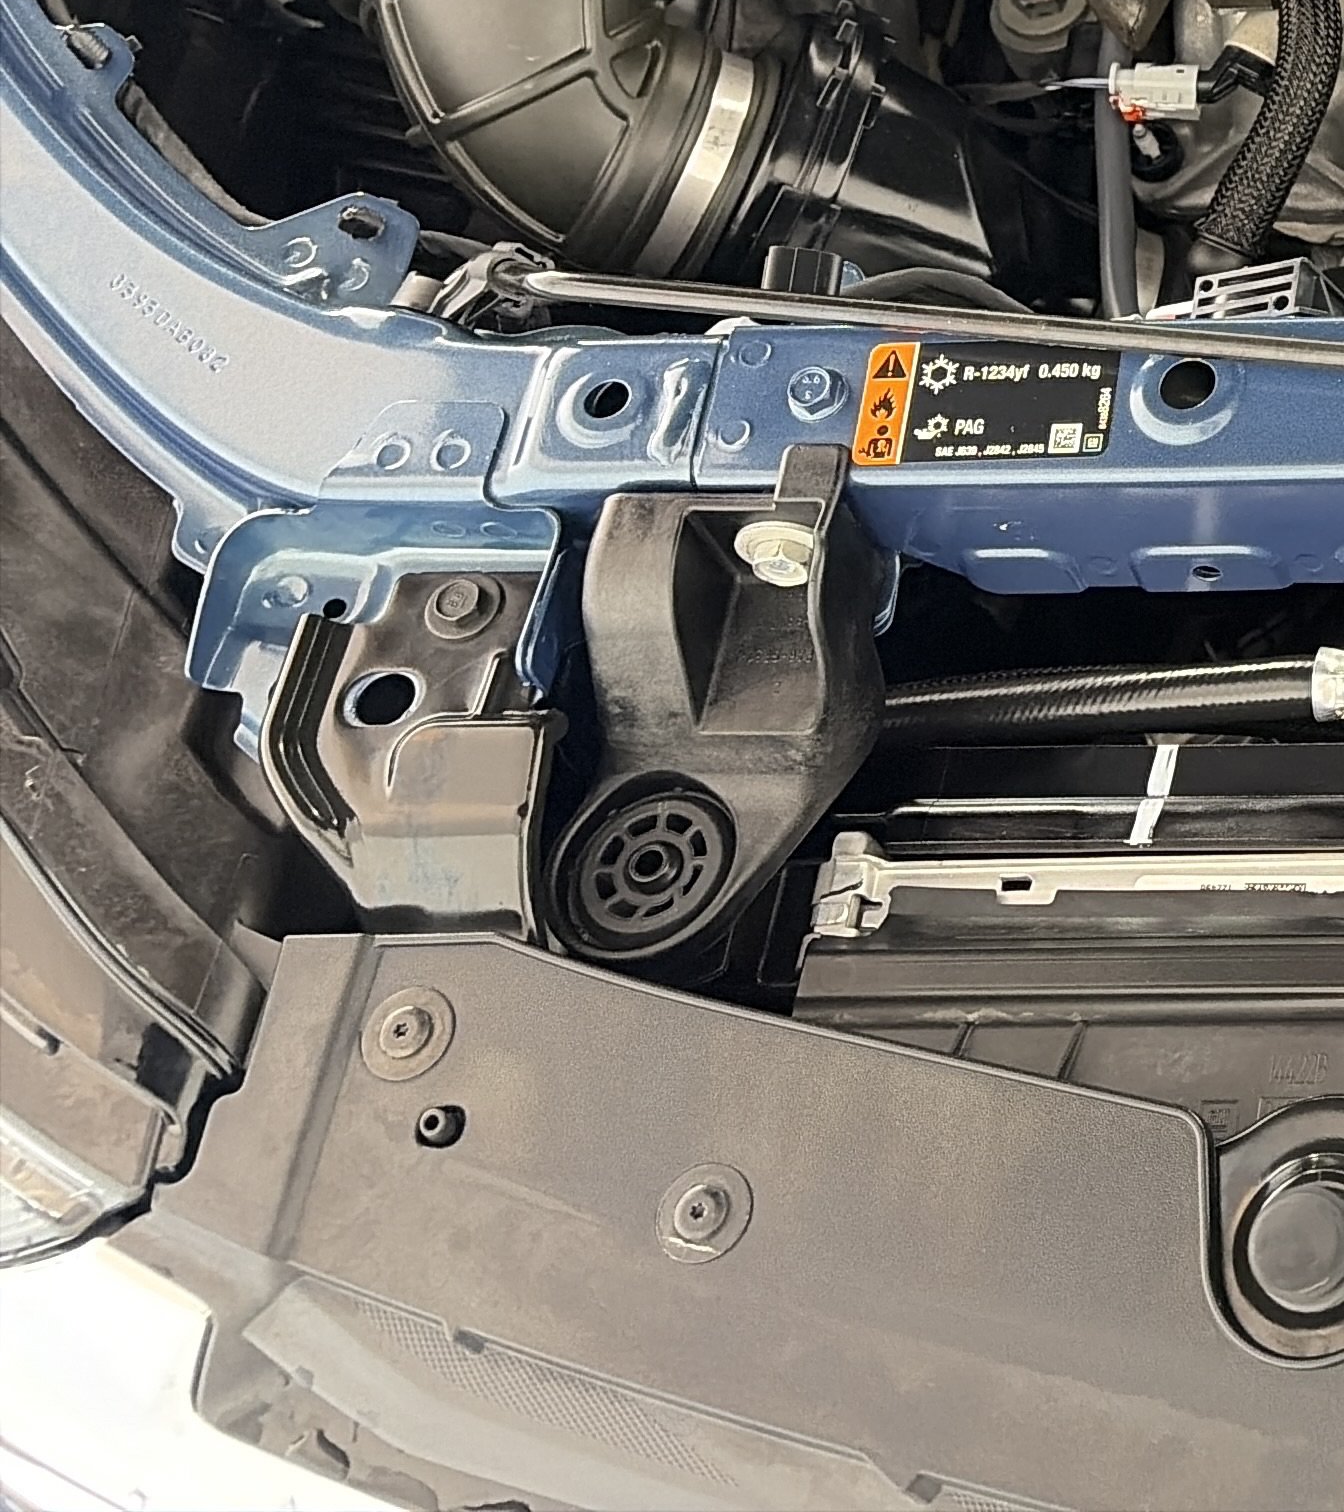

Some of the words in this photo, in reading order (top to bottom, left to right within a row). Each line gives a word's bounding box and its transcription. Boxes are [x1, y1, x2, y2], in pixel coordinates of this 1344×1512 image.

[963, 364, 1031, 382] R-1234yf
[1038, 363, 1079, 378] 0.450
[1081, 362, 1101, 379] kg
[954, 418, 985, 435] PAG
[935, 446, 954, 457] SAE
